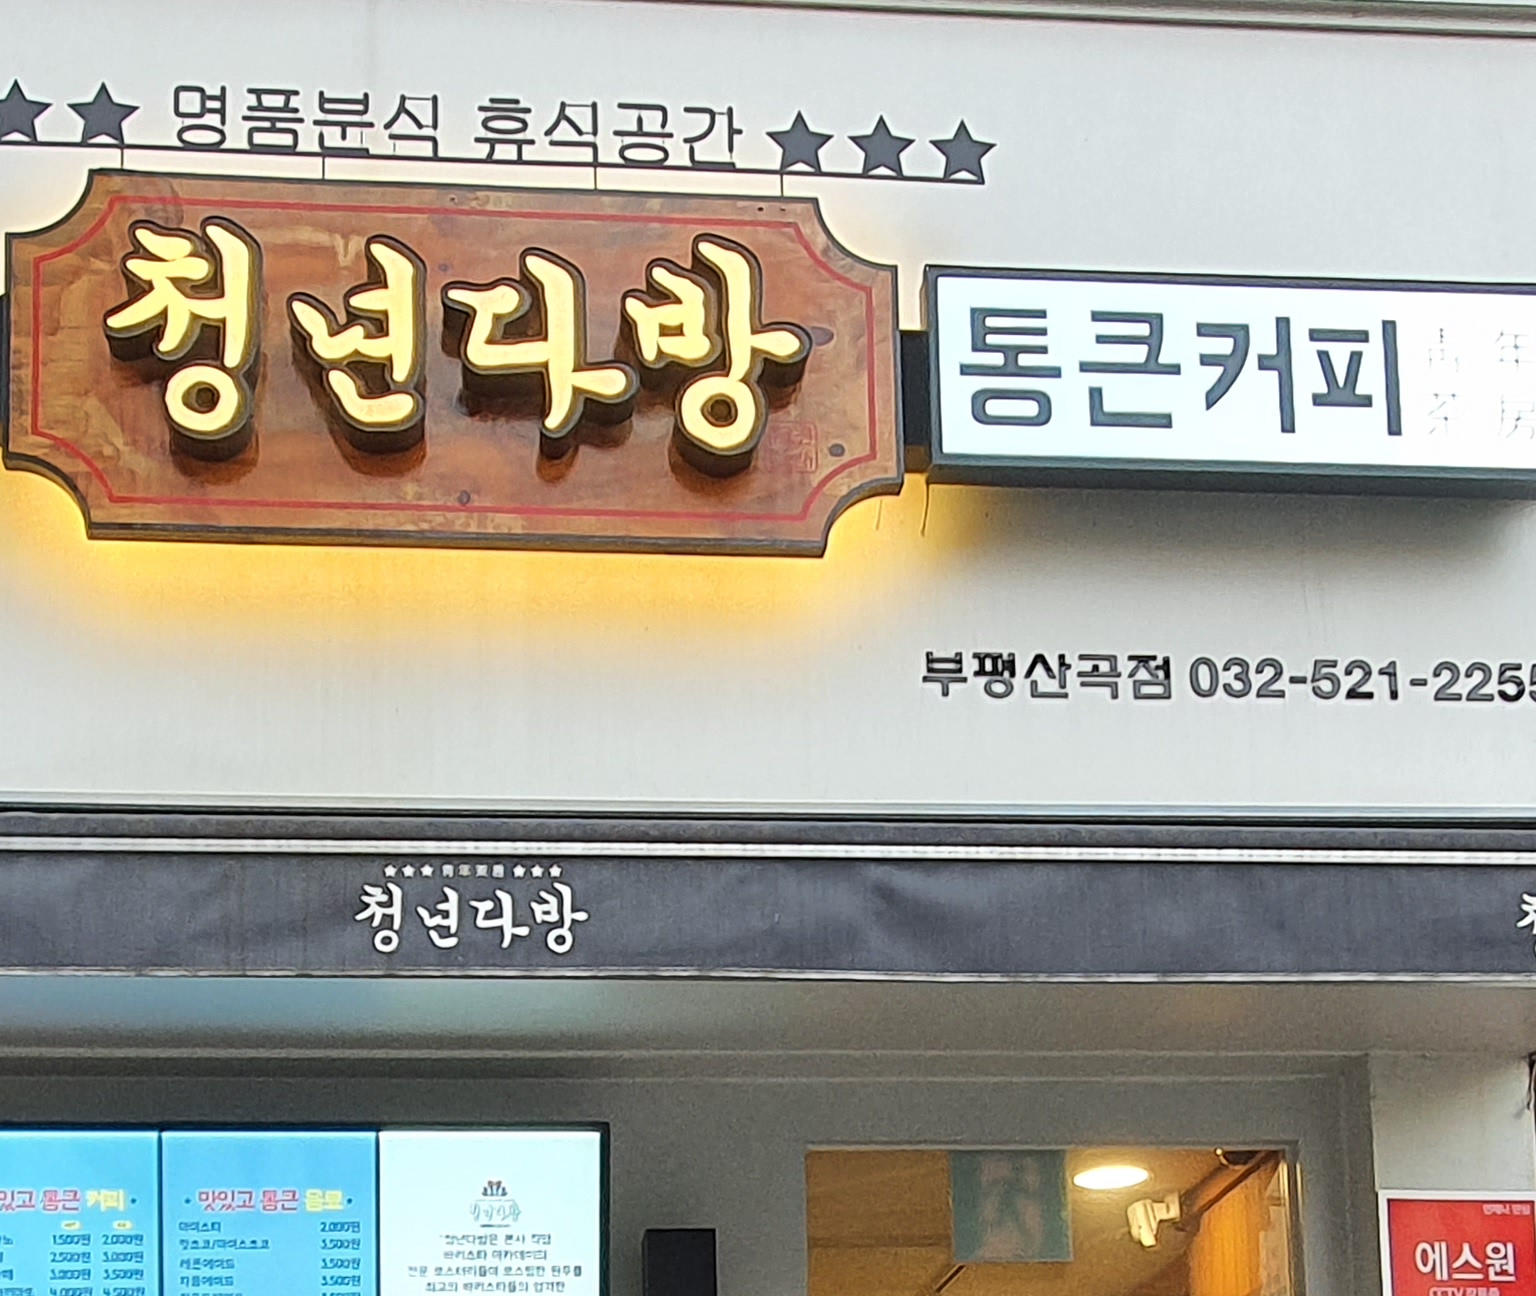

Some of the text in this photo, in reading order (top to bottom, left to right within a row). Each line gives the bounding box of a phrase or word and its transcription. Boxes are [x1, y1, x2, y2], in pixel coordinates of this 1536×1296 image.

[173, 83, 742, 168] 명품분식 휴식공간
[104, 217, 814, 470] 청년다방
[959, 306, 1403, 436] 통큰커피
[922, 652, 1172, 700] 부평산곡점
[354, 882, 589, 953] 청년다방
[1415, 1241, 1517, 1282] 에스원
